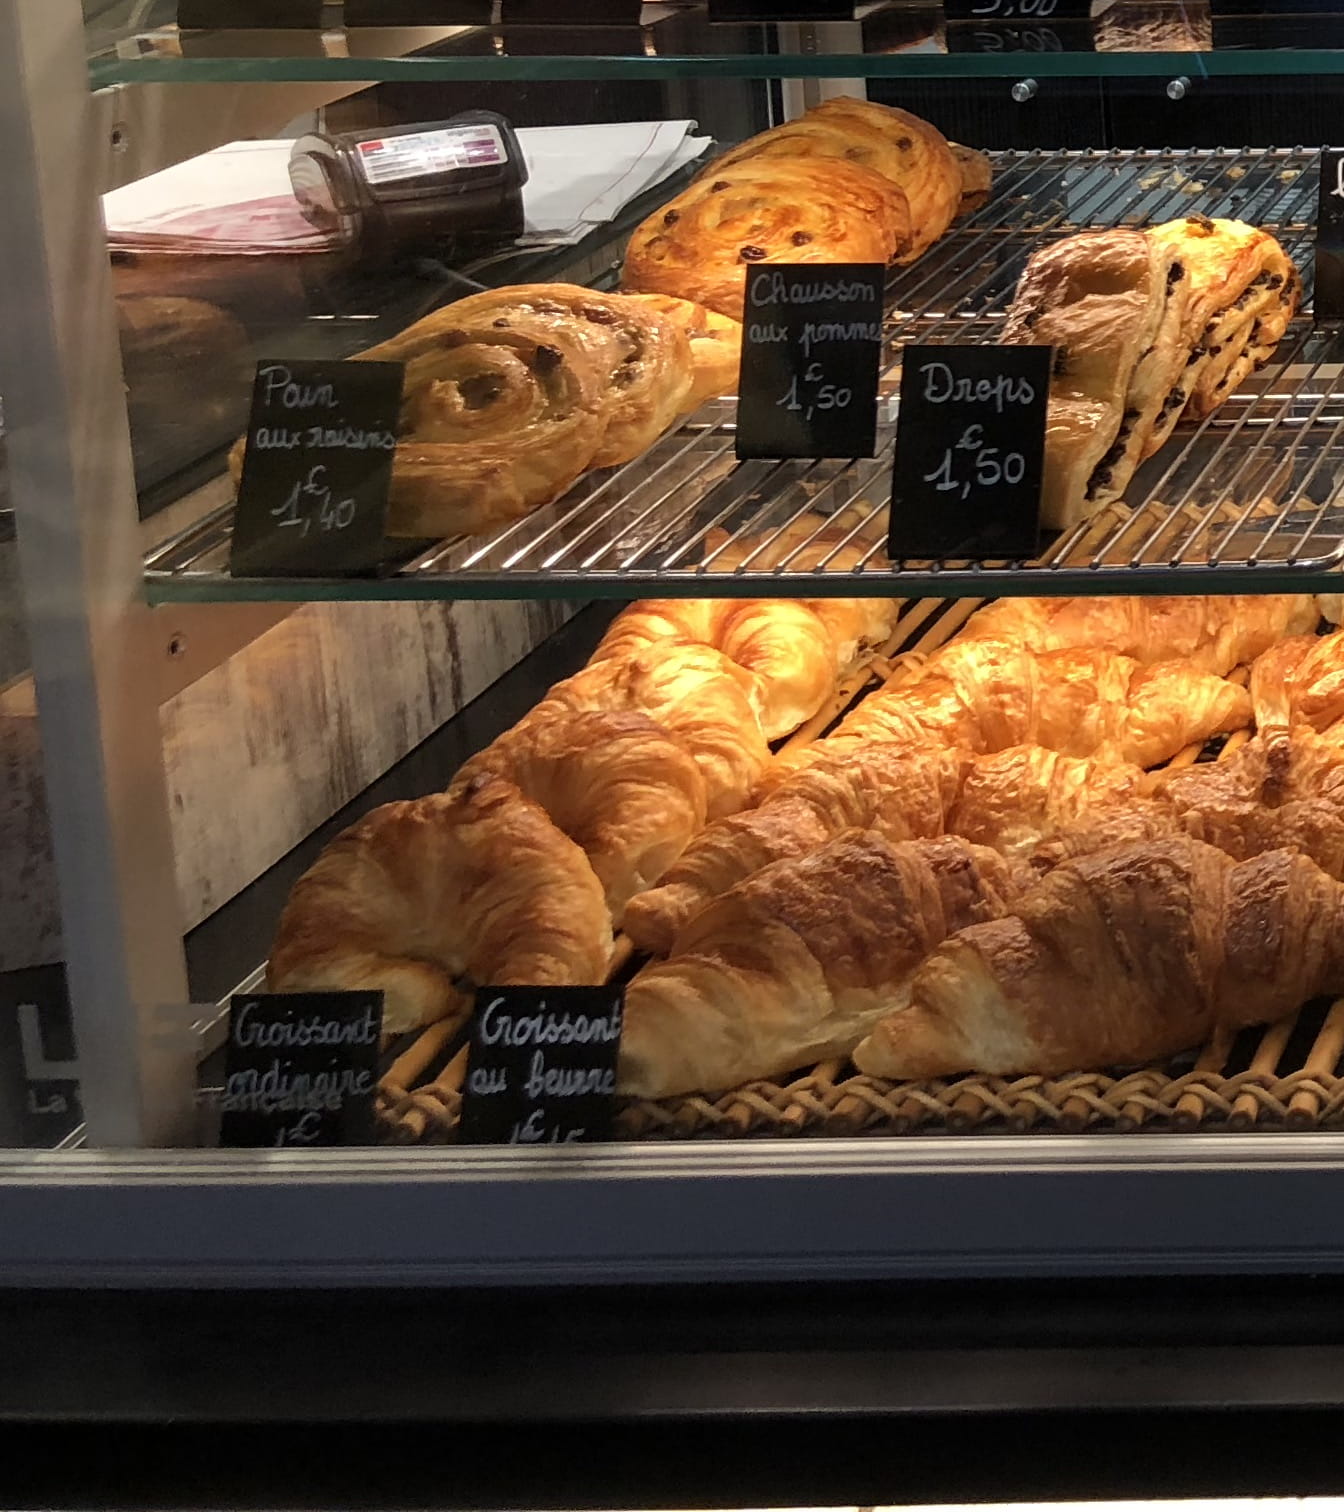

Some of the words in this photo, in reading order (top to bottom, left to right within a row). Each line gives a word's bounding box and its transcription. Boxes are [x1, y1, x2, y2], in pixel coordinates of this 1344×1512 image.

[750, 271, 875, 306] Chausson
[750, 323, 789, 343] aux
[259, 365, 339, 408] Pain
[920, 362, 1035, 412] Drops
[256, 428, 301, 449] aux
[235, 1001, 377, 1047] Croissant
[480, 997, 621, 1045] Croissant
[469, 1068, 507, 1094] au
[524, 1050, 615, 1098] beurre
